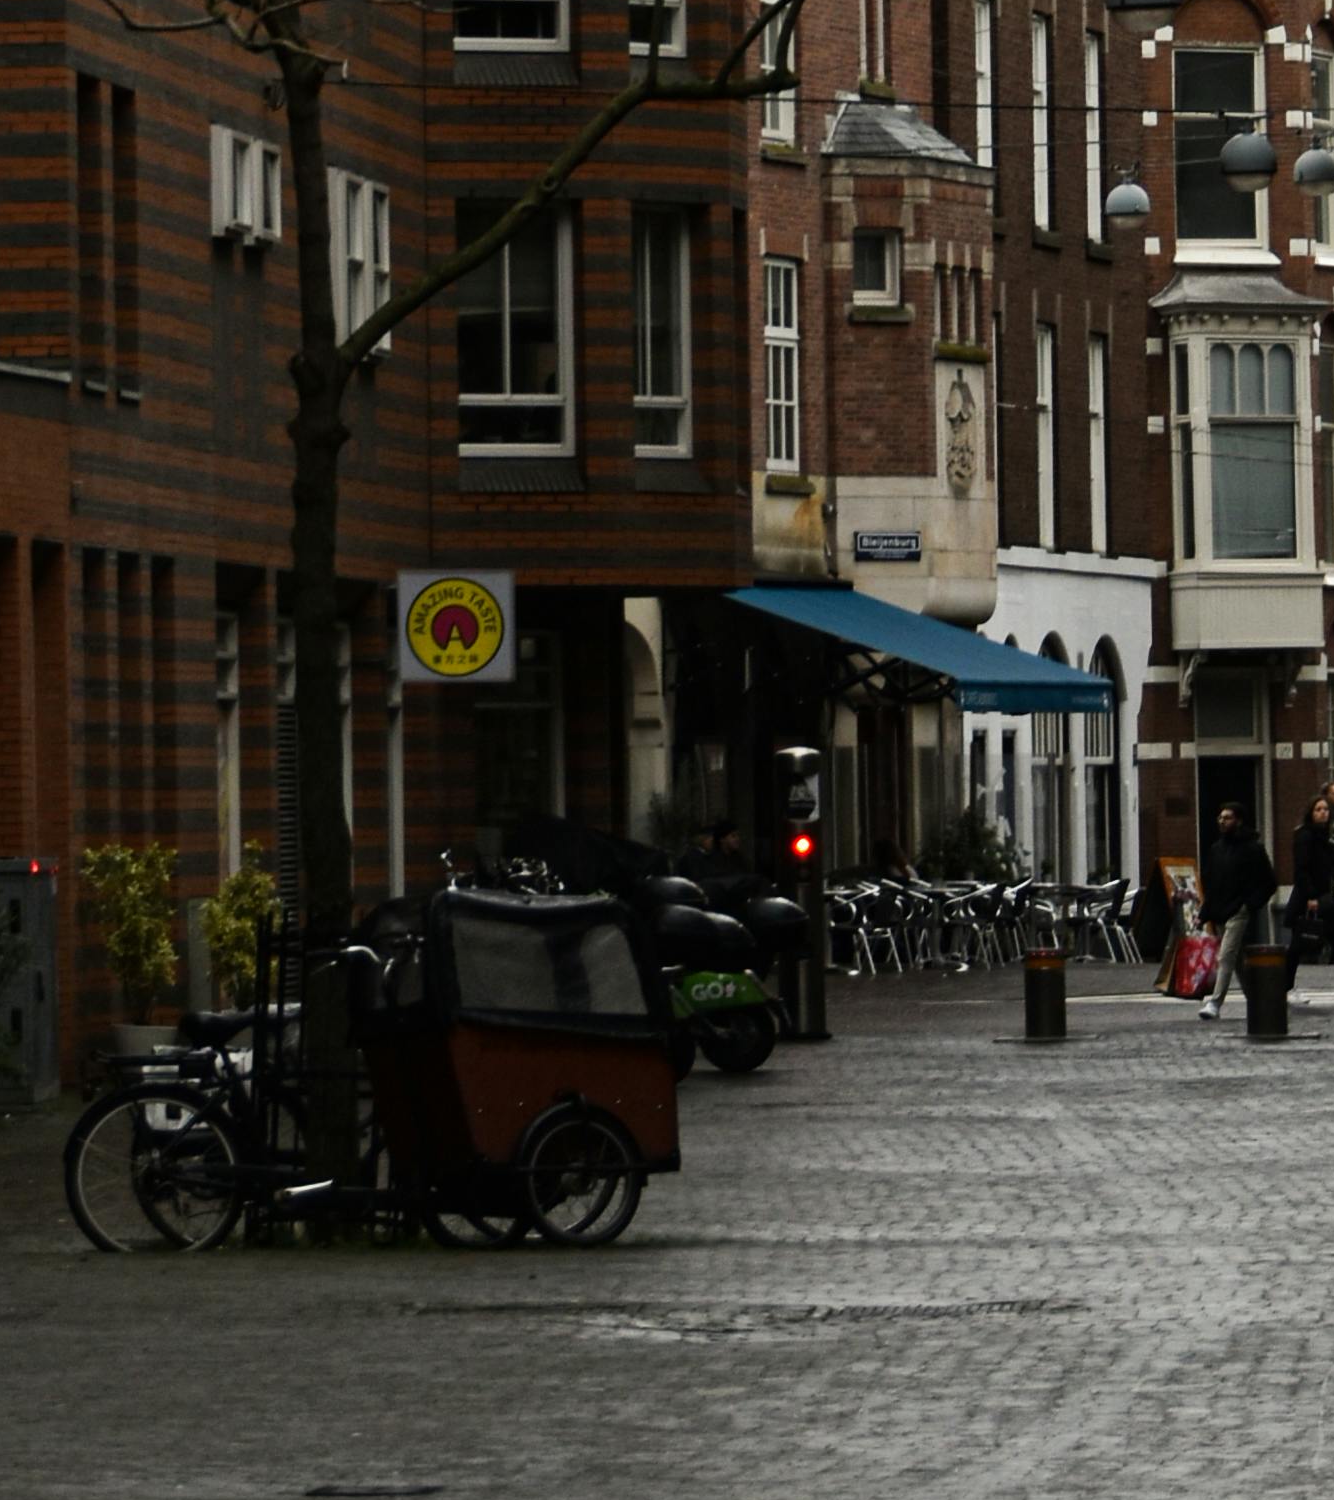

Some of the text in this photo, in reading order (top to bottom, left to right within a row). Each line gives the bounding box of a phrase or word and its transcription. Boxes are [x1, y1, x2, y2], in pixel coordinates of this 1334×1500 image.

[862, 536, 916, 551] Bleijenburg
[413, 587, 497, 635] AMAZING TASTE
